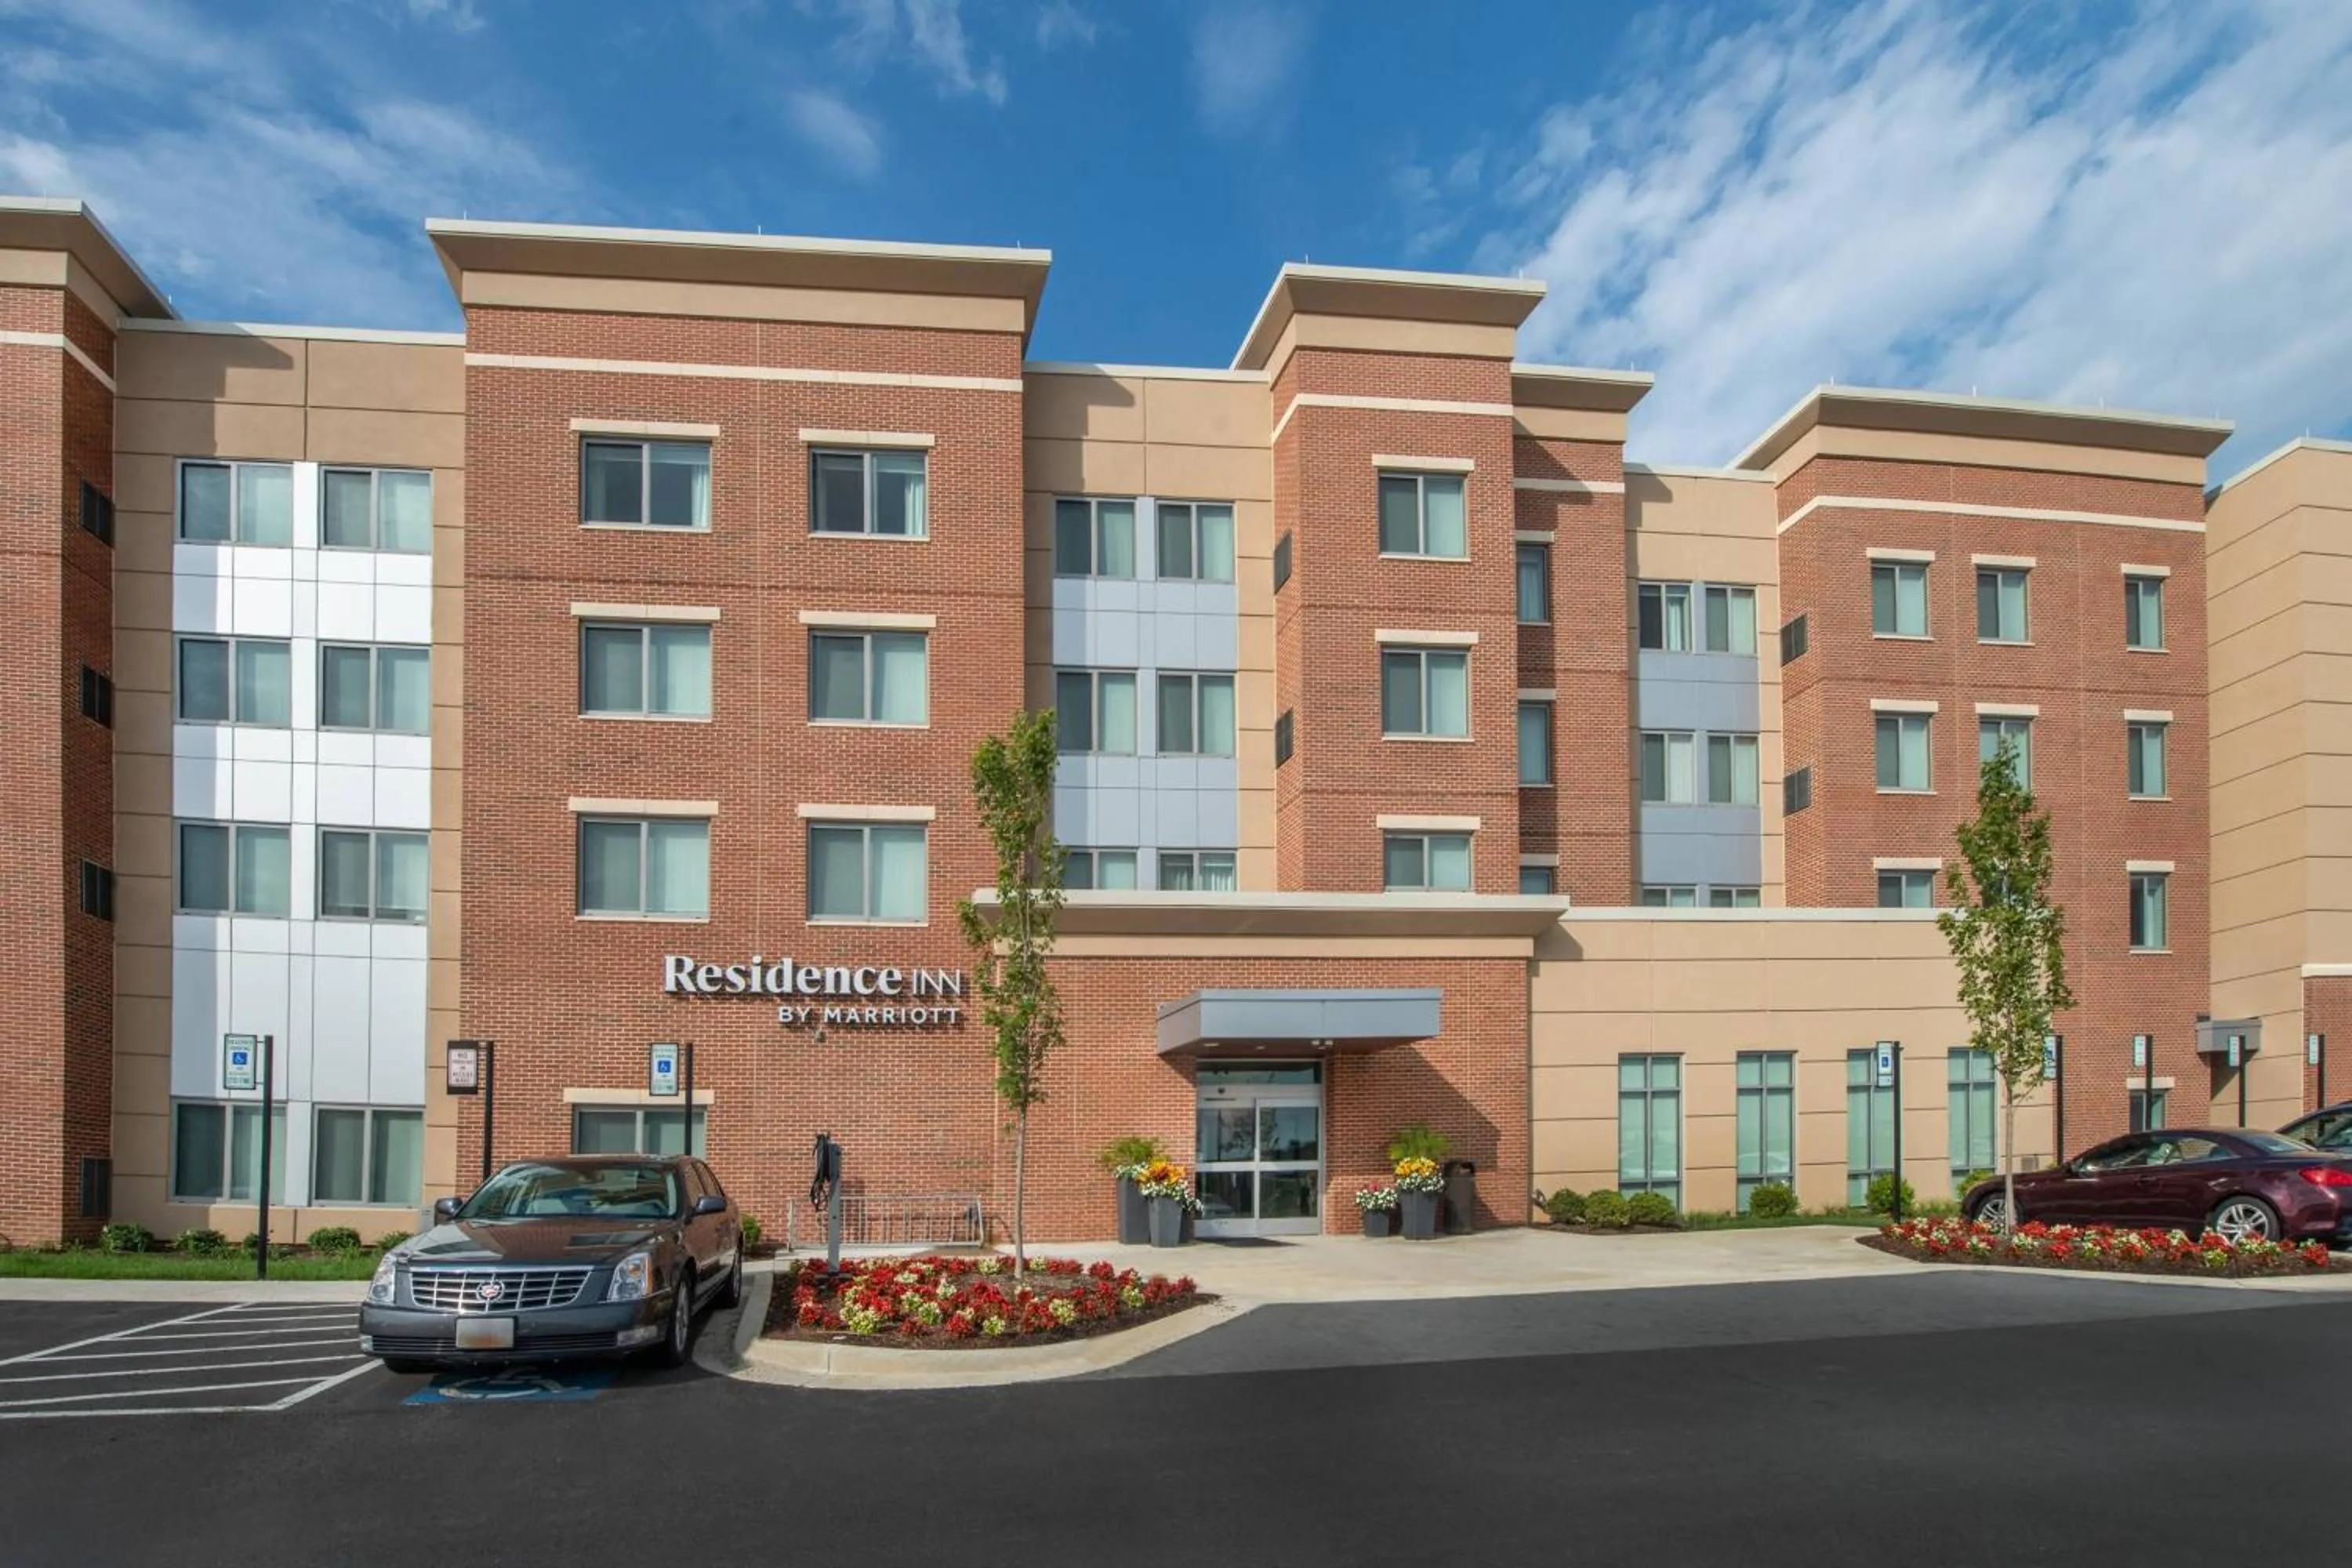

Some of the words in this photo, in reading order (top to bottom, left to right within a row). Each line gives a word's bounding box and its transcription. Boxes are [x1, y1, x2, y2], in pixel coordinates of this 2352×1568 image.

[664, 956, 902, 995] Residence
[912, 968, 960, 995] INN
[779, 1006, 812, 1022] BY
[824, 1007, 960, 1024] MARRIOTT
